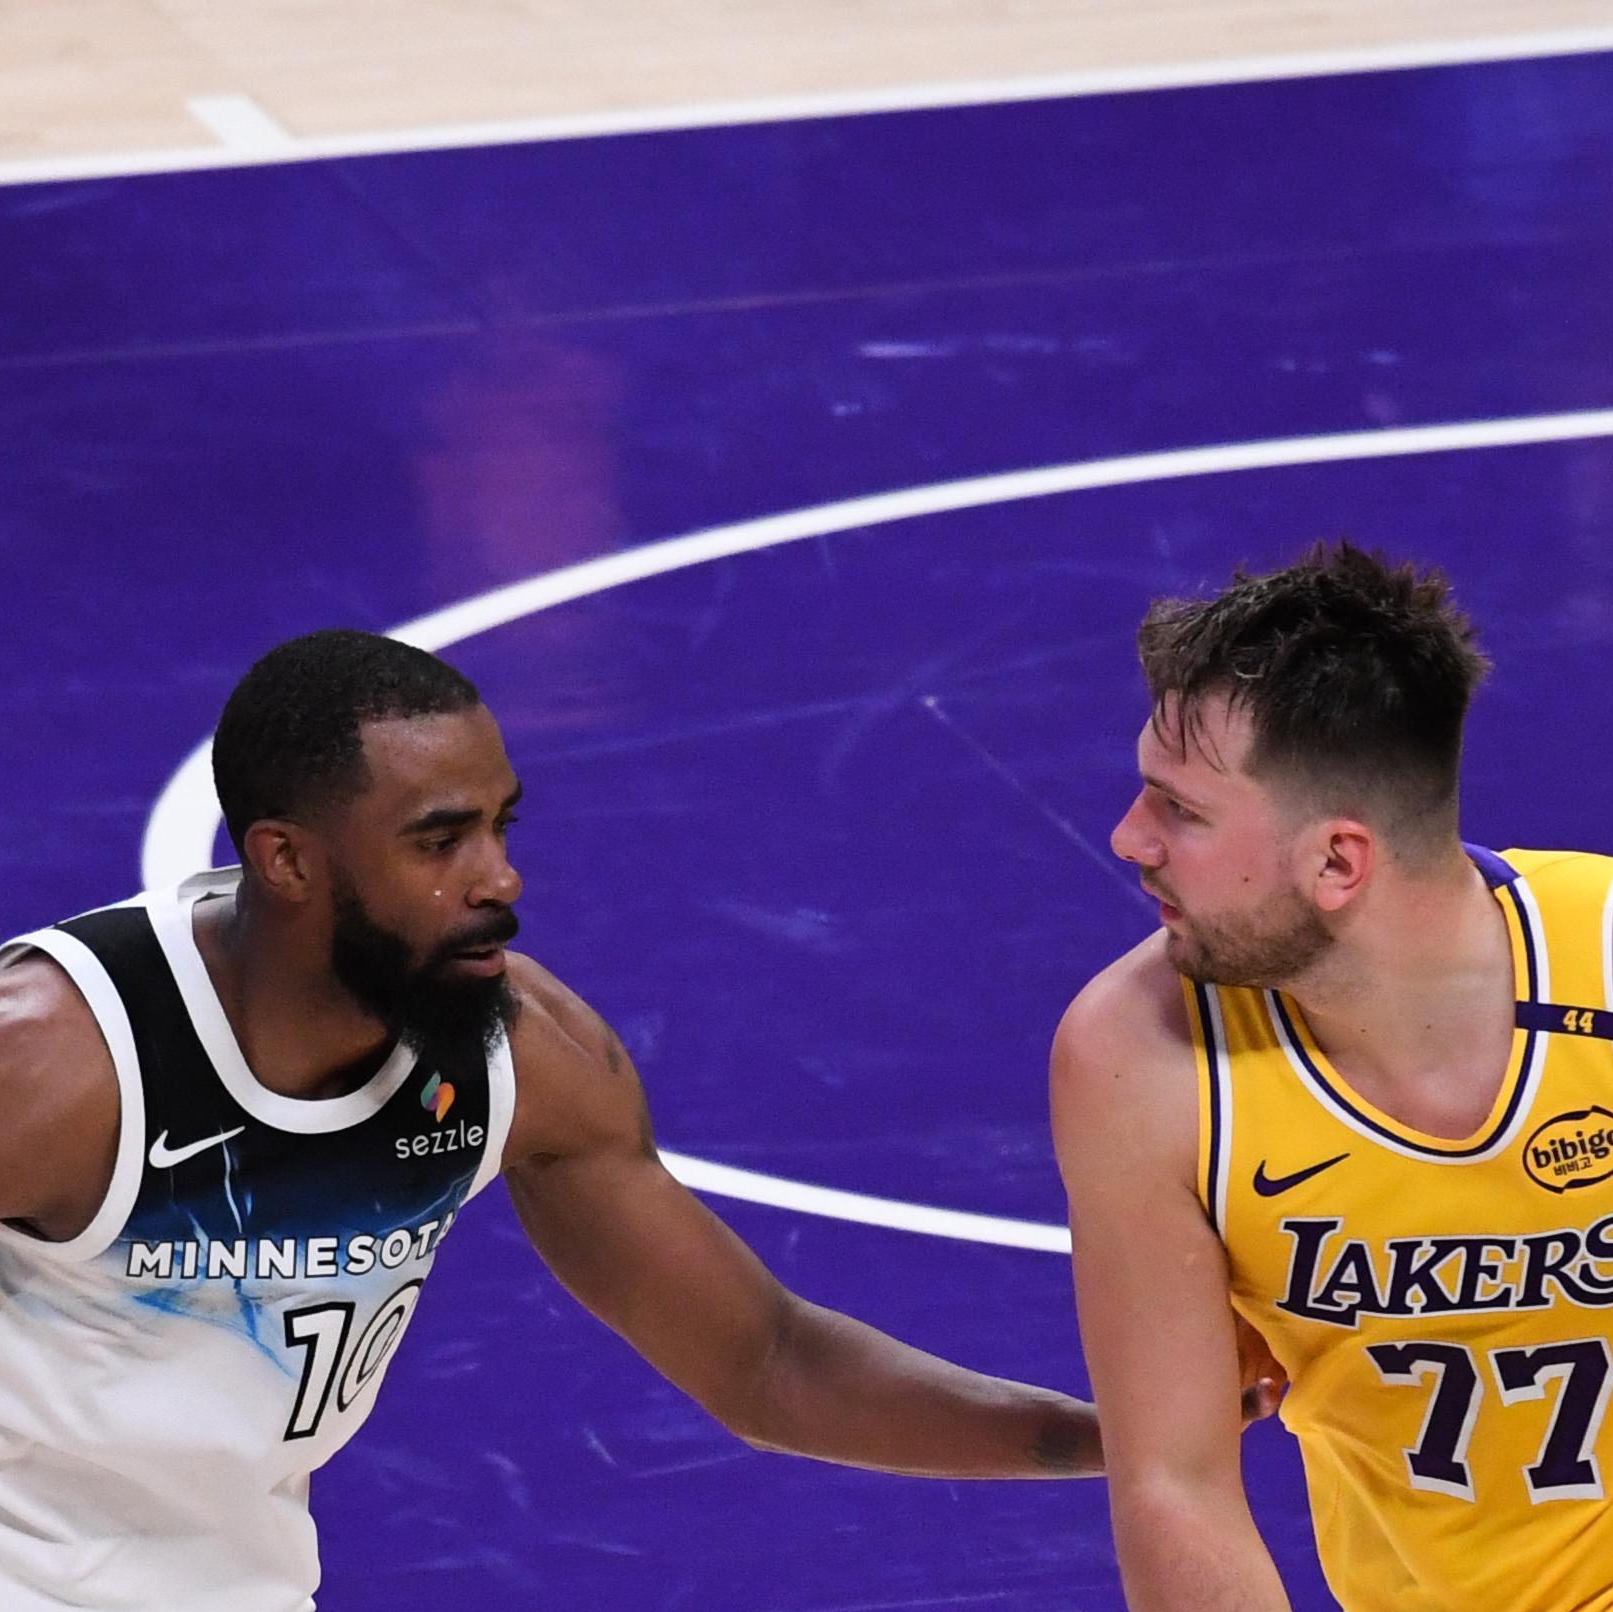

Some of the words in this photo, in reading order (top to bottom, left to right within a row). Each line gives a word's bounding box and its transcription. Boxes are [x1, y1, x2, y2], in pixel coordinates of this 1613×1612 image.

[1562, 1008, 1595, 1034] 44
[394, 1119, 485, 1159] sezzle
[1552, 1157, 1593, 1177] 비비고
[283, 1278, 425, 1443] 10
